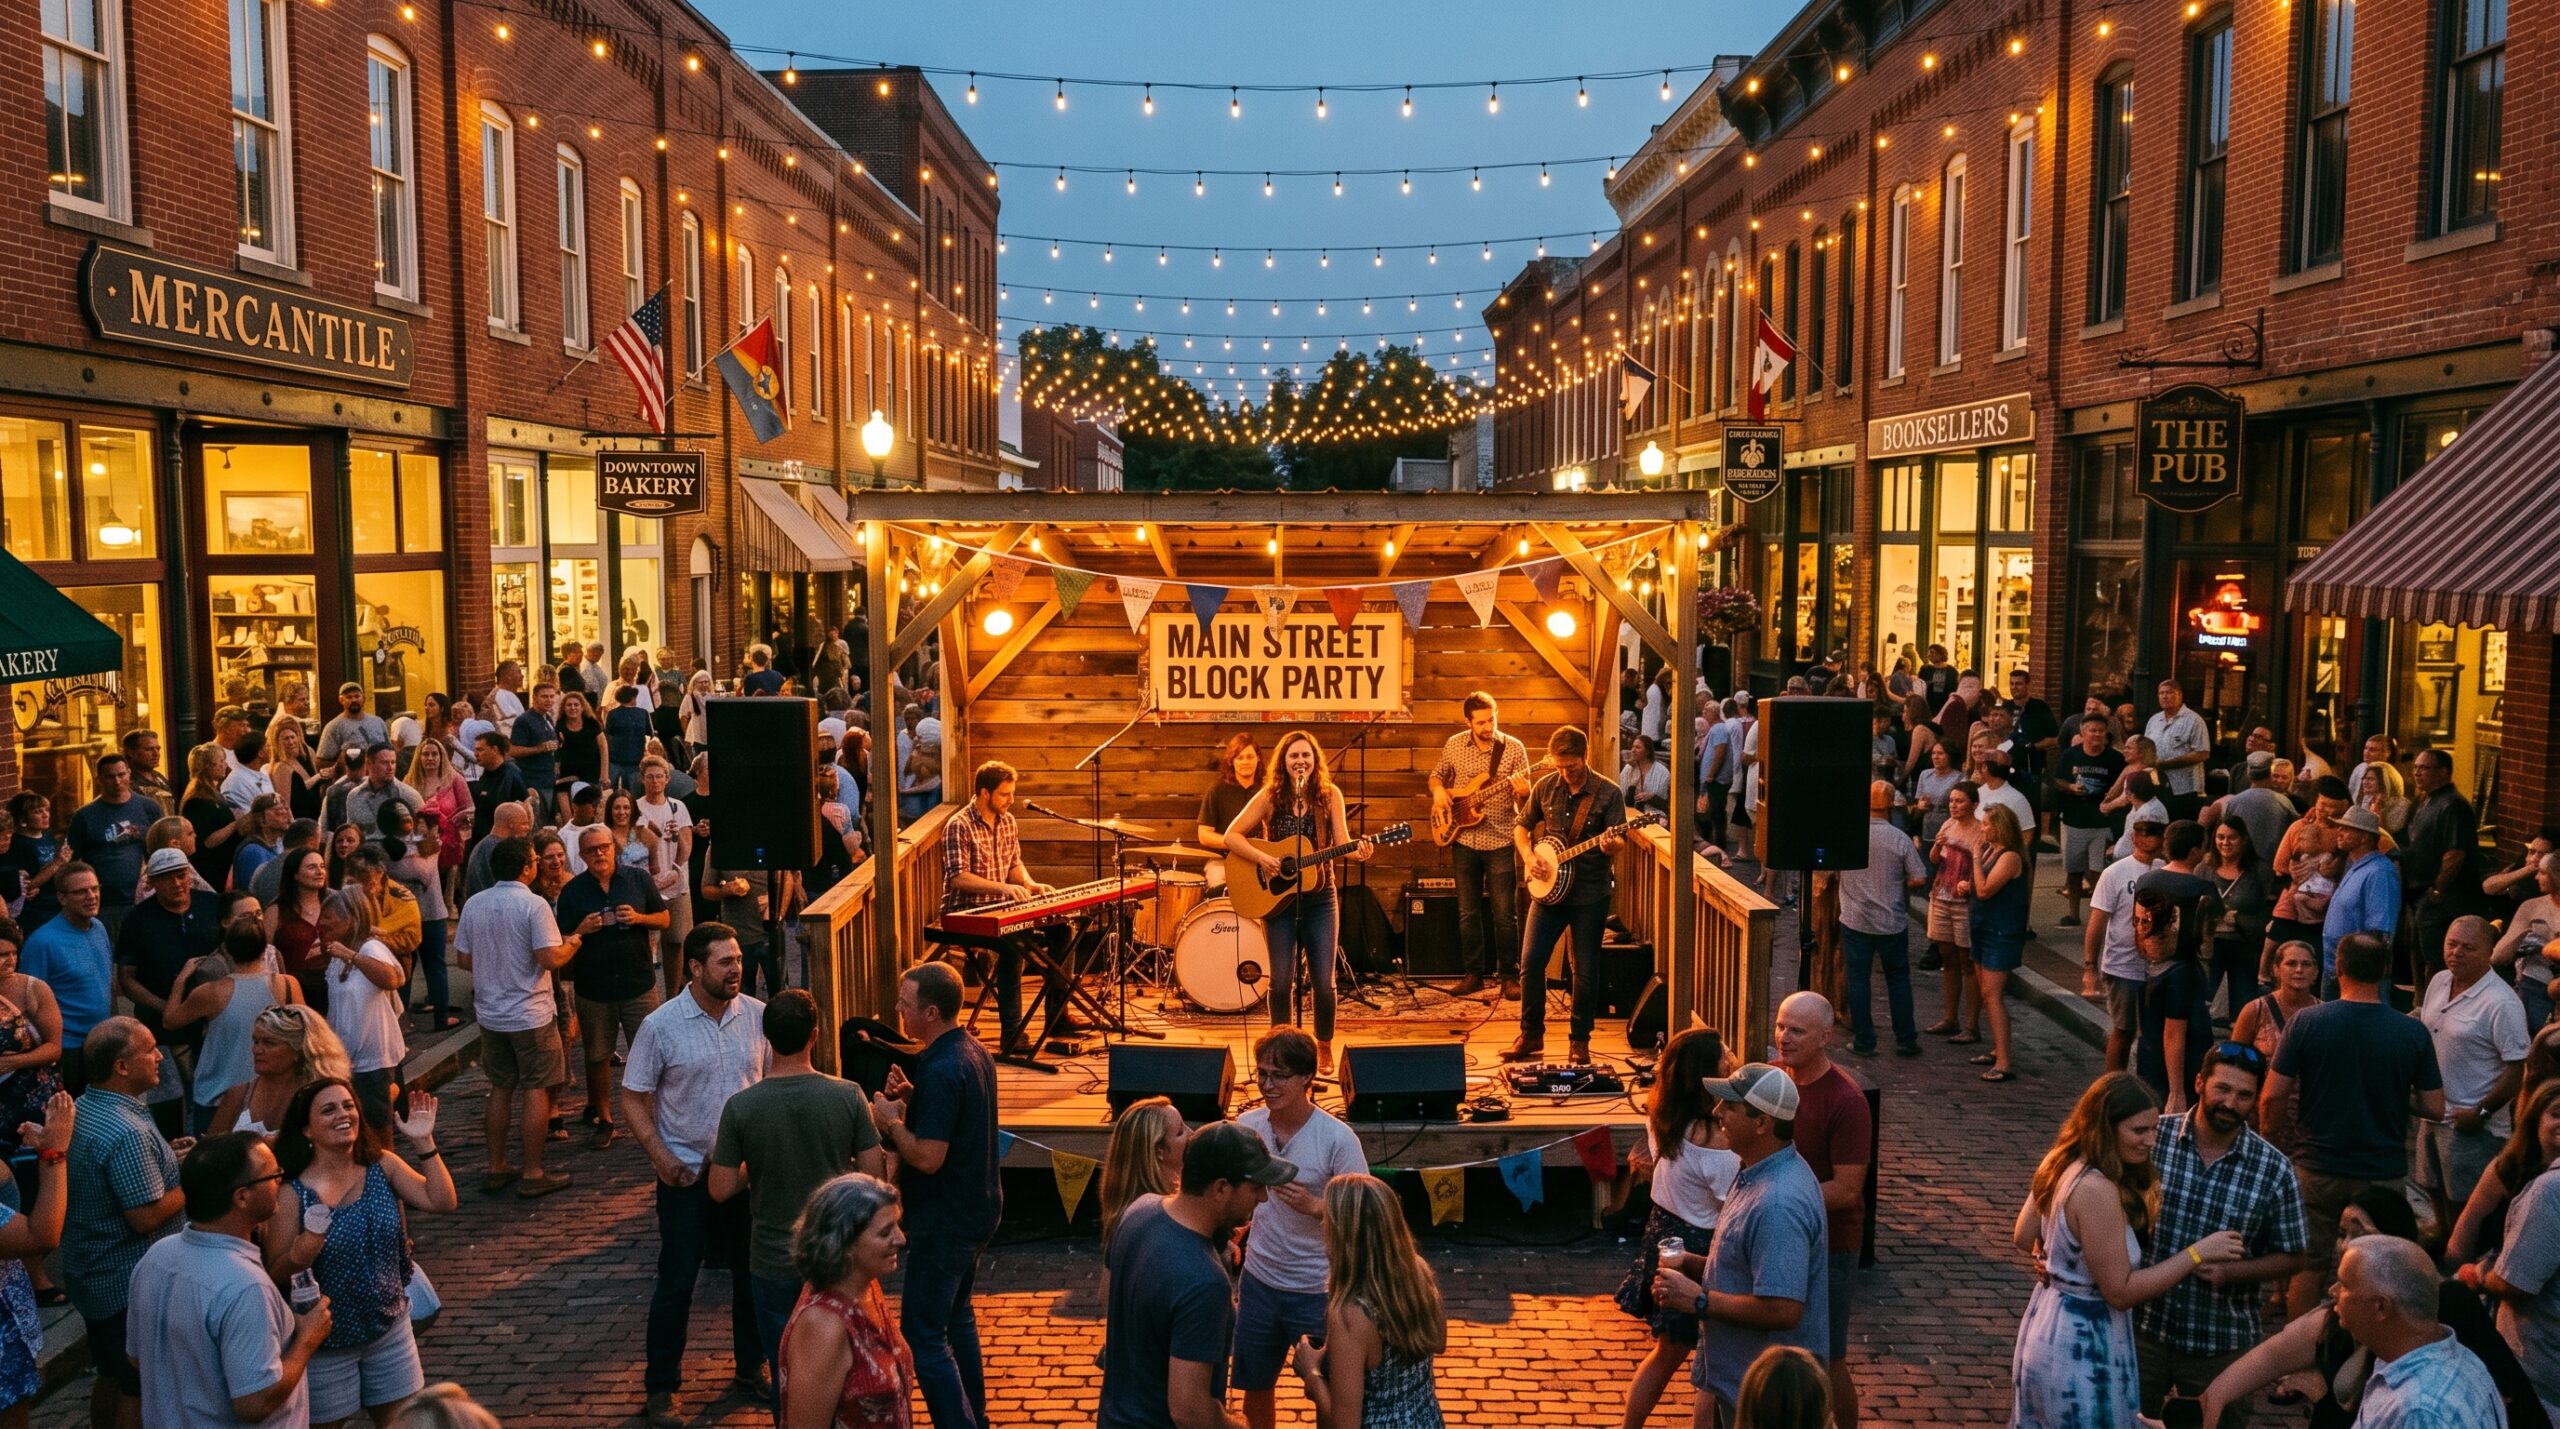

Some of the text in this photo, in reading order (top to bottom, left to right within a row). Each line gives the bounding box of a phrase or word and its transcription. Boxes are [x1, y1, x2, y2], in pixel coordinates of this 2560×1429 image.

[128, 268, 396, 371] MERCANTILE
[1883, 403, 2009, 451] BOOKSELLERS
[2152, 420, 2228, 449] THE
[604, 461, 696, 474] DOWNTOWN
[2150, 453, 2227, 483] PUB
[604, 476, 696, 496] BAKERY
[1168, 624, 1385, 659] MAIN STREET
[1167, 665, 1385, 699] BLOCK PARTY
